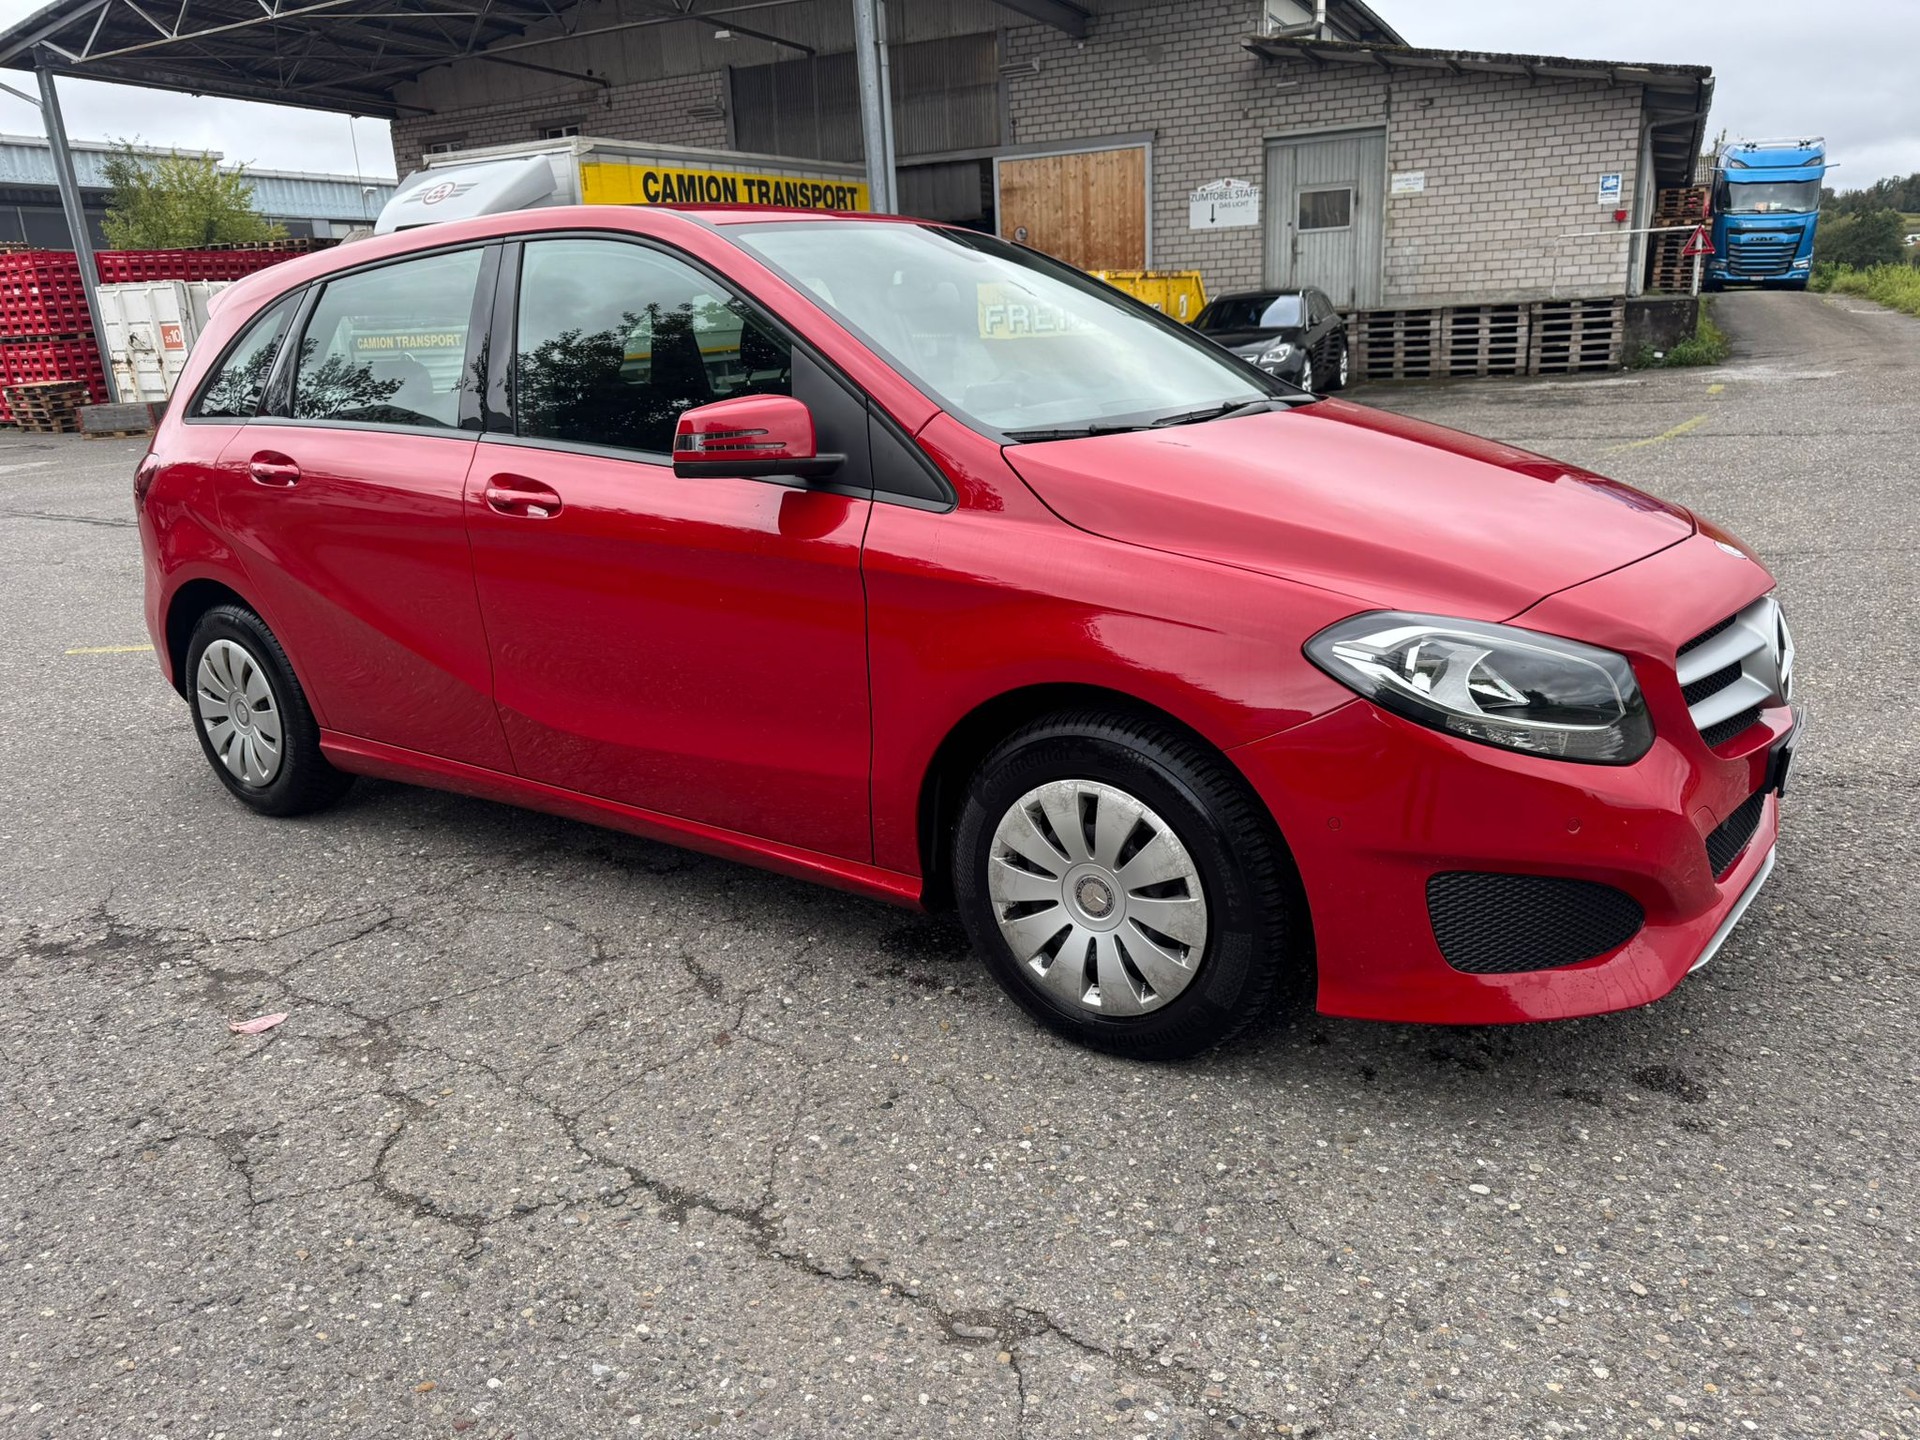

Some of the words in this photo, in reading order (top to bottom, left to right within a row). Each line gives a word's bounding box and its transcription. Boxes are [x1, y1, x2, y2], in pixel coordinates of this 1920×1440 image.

[643, 171, 736, 203] CAMION
[743, 178, 857, 211] TRANSPORT
[1190, 191, 1233, 202] ZUMTOBEL
[1234, 188, 1258, 199] STAFF
[357, 336, 393, 349] CAMION
[396, 334, 462, 348] TRANSPORT
